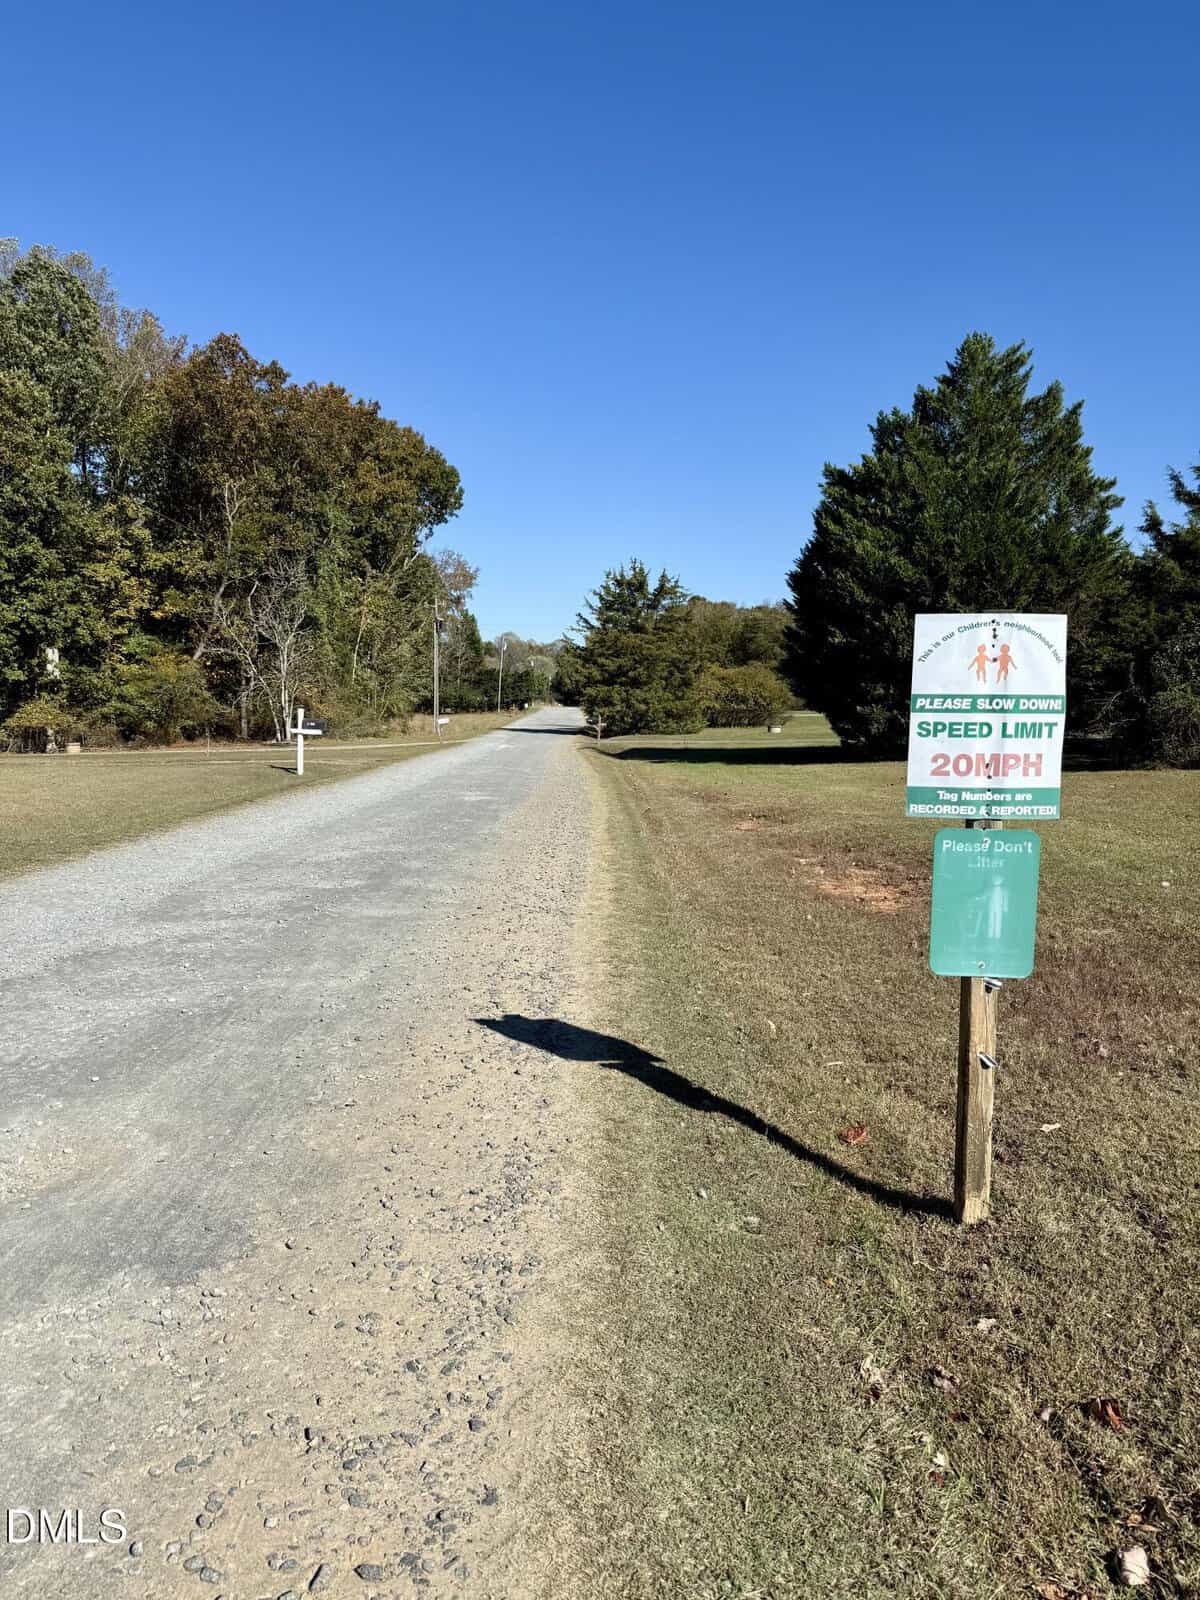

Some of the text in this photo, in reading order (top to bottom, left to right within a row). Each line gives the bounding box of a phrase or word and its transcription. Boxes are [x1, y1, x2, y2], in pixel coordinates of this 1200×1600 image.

[918, 648, 934, 663] This
[931, 640, 942, 649] is
[941, 631, 956, 642] our
[957, 621, 1001, 633] Childrens
[1003, 621, 1054, 650] neighborhood
[916, 698, 1062, 710] PLEASE SLOW DOWN!
[917, 721, 1058, 739] SPEED LIMIT
[930, 753, 1043, 777] 20MPH
[937, 790, 1033, 802] Tag Numbers are
[909, 804, 977, 815] RECORDED
[991, 805, 1056, 815] REPORTED!
[942, 839, 1033, 853] Please Don't
